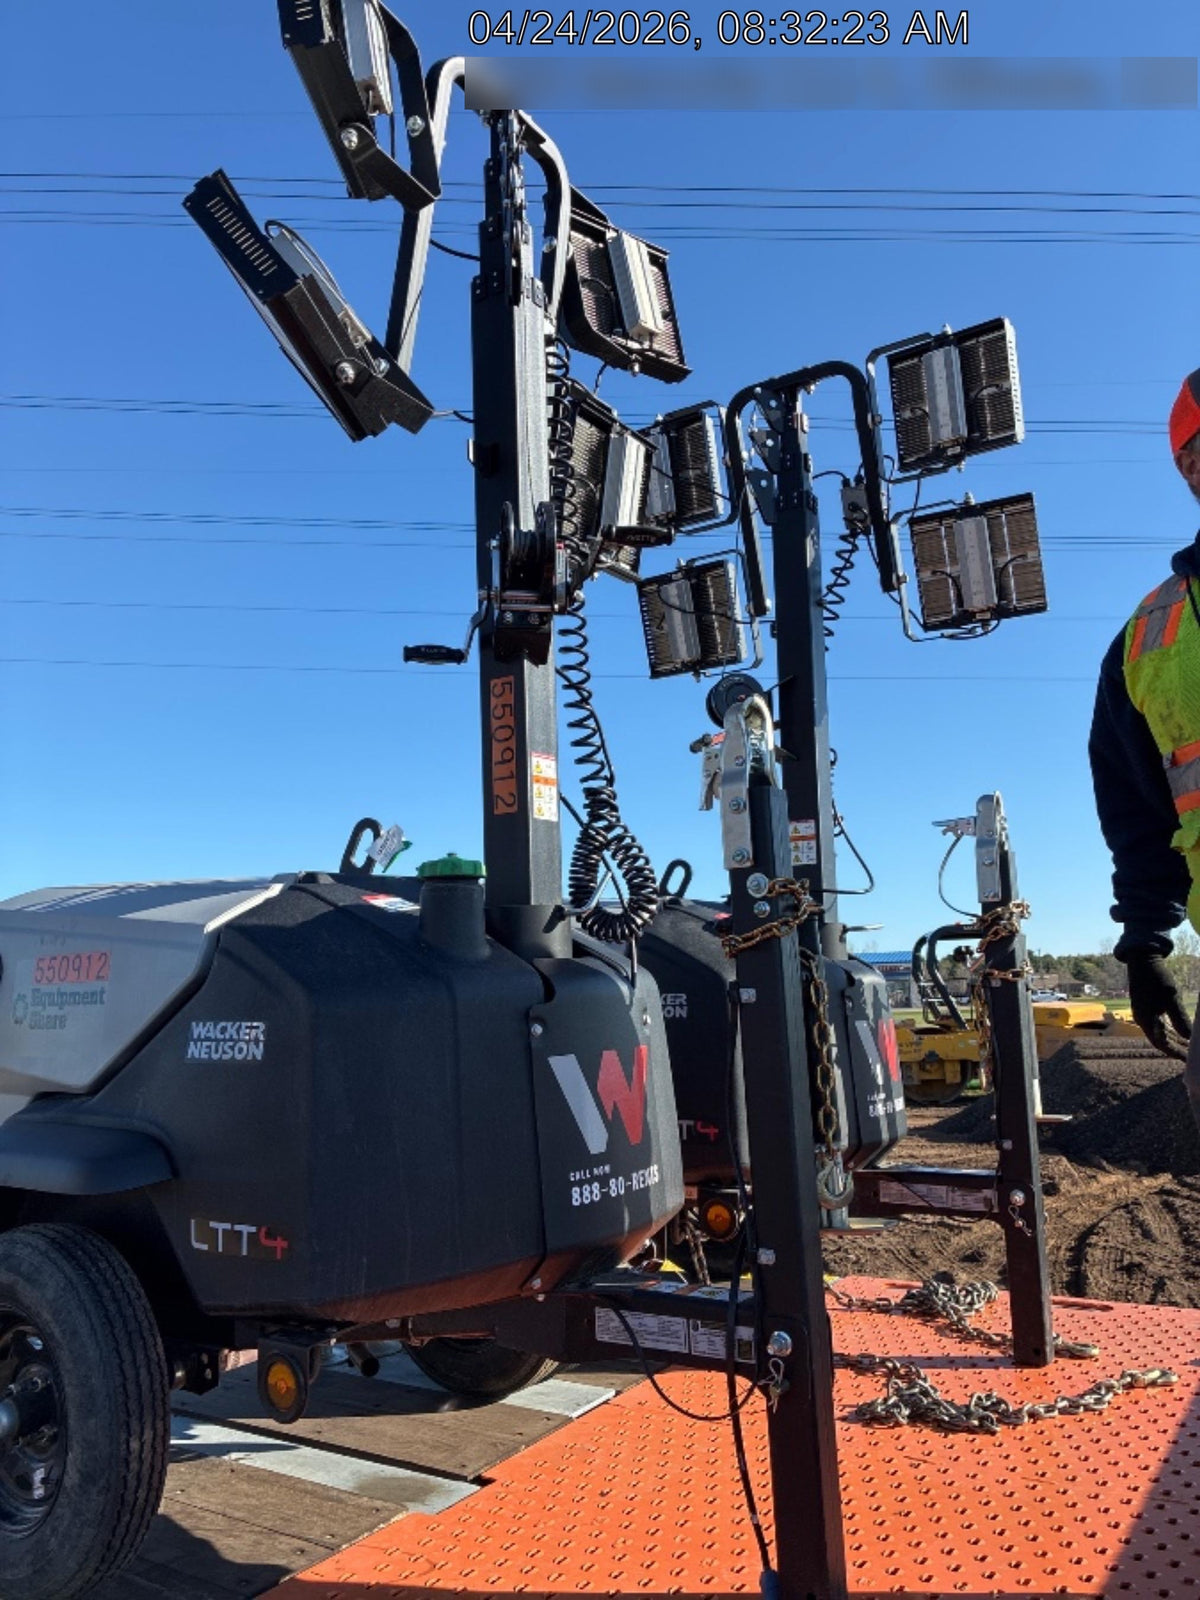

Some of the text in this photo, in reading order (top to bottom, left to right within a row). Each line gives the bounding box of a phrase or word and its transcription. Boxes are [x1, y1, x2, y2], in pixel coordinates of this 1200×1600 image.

[491, 681, 516, 809] 550912
[35, 952, 107, 983] 550912
[30, 986, 105, 1010] Equipment
[192, 1021, 265, 1040] WACKER
[187, 1041, 263, 1060] NEUSON
[191, 1219, 288, 1260] LTT4
